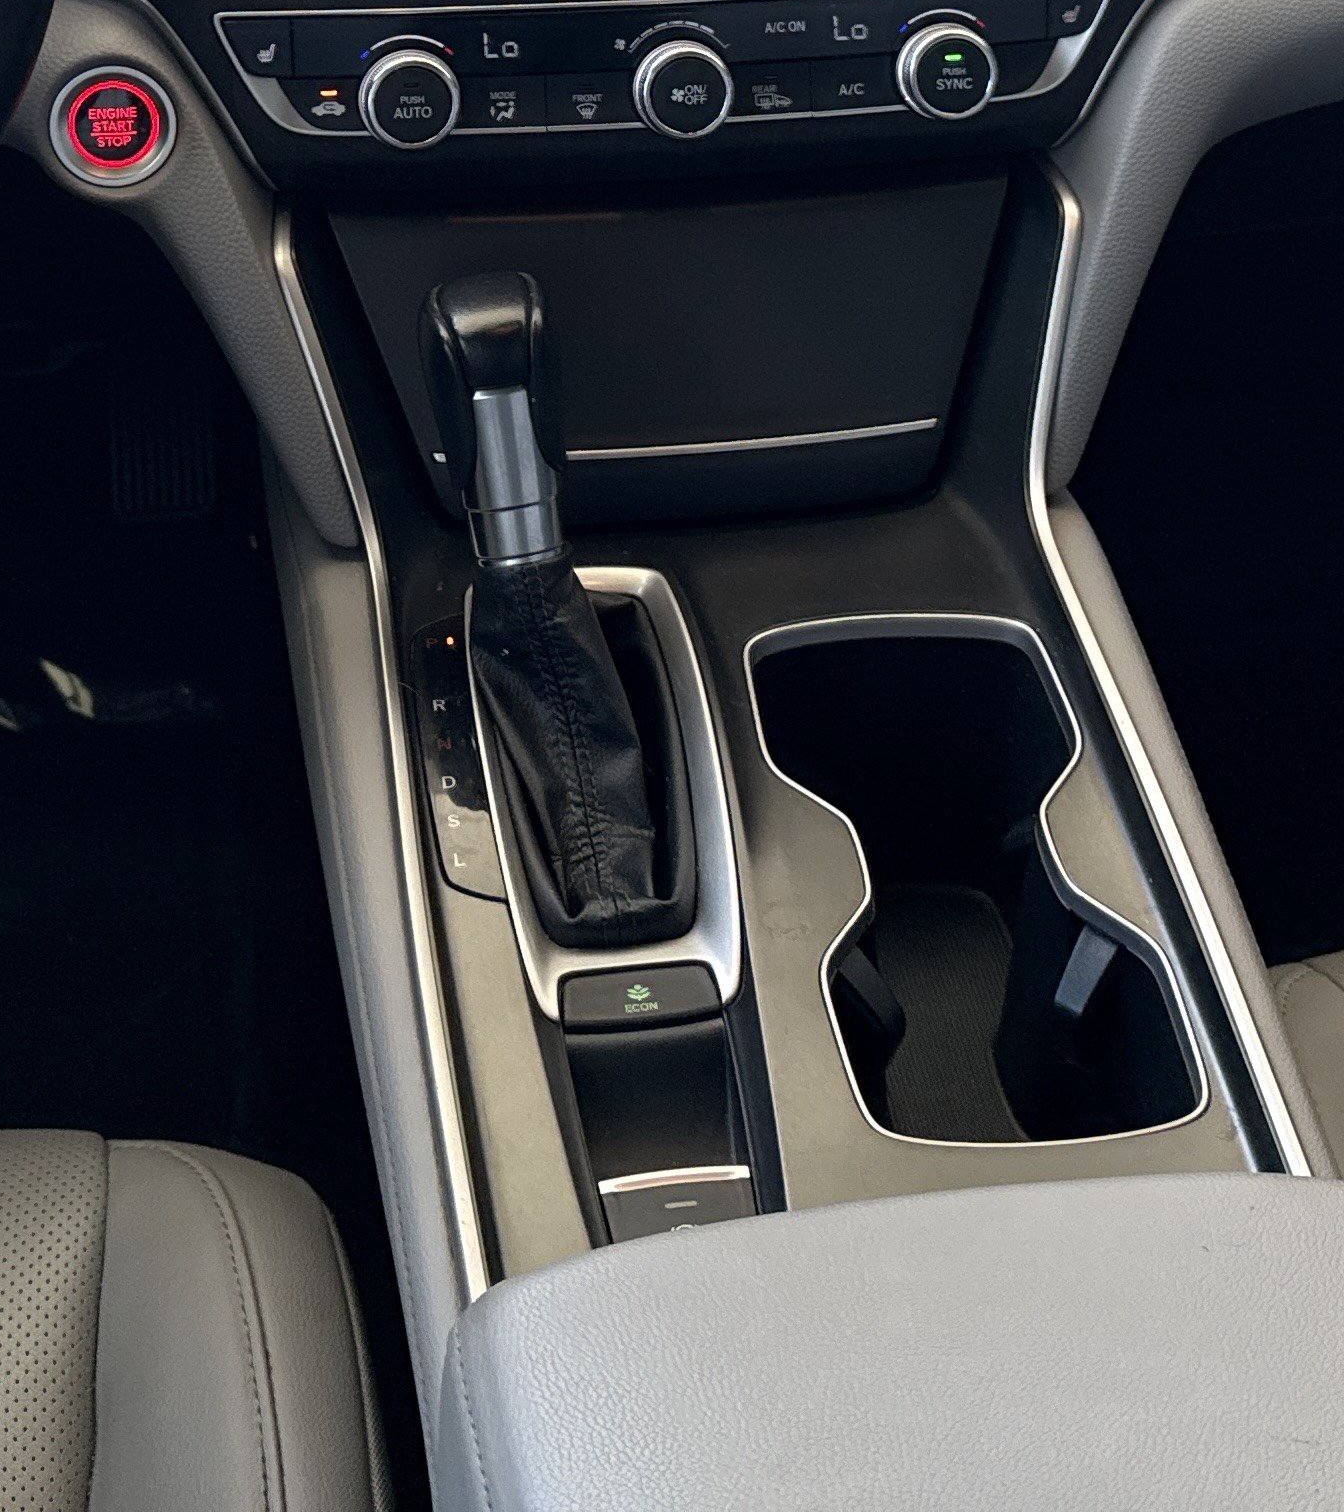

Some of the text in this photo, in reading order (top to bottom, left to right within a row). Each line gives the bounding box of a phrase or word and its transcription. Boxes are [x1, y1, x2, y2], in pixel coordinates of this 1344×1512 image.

[764, 20, 807, 34] A/C ON
[832, 15, 869, 41] Lo
[482, 32, 520, 59] Lo
[941, 67, 967, 76] PUSH
[838, 82, 866, 96] A/C
[936, 77, 974, 90] SYNC
[399, 95, 426, 105] PUSH
[489, 90, 517, 100] MODE
[571, 92, 604, 103] FRONT
[684, 94, 709, 105] OFF
[88, 106, 138, 120] ENGINE
[393, 106, 433, 119] AUTO
[92, 120, 135, 132] START
[96, 135, 132, 148] STOP
[432, 699, 446, 712] R
[441, 775, 457, 789] D
[447, 814, 461, 828] S
[453, 852, 467, 868] L
[624, 1001, 659, 1014] ECON
